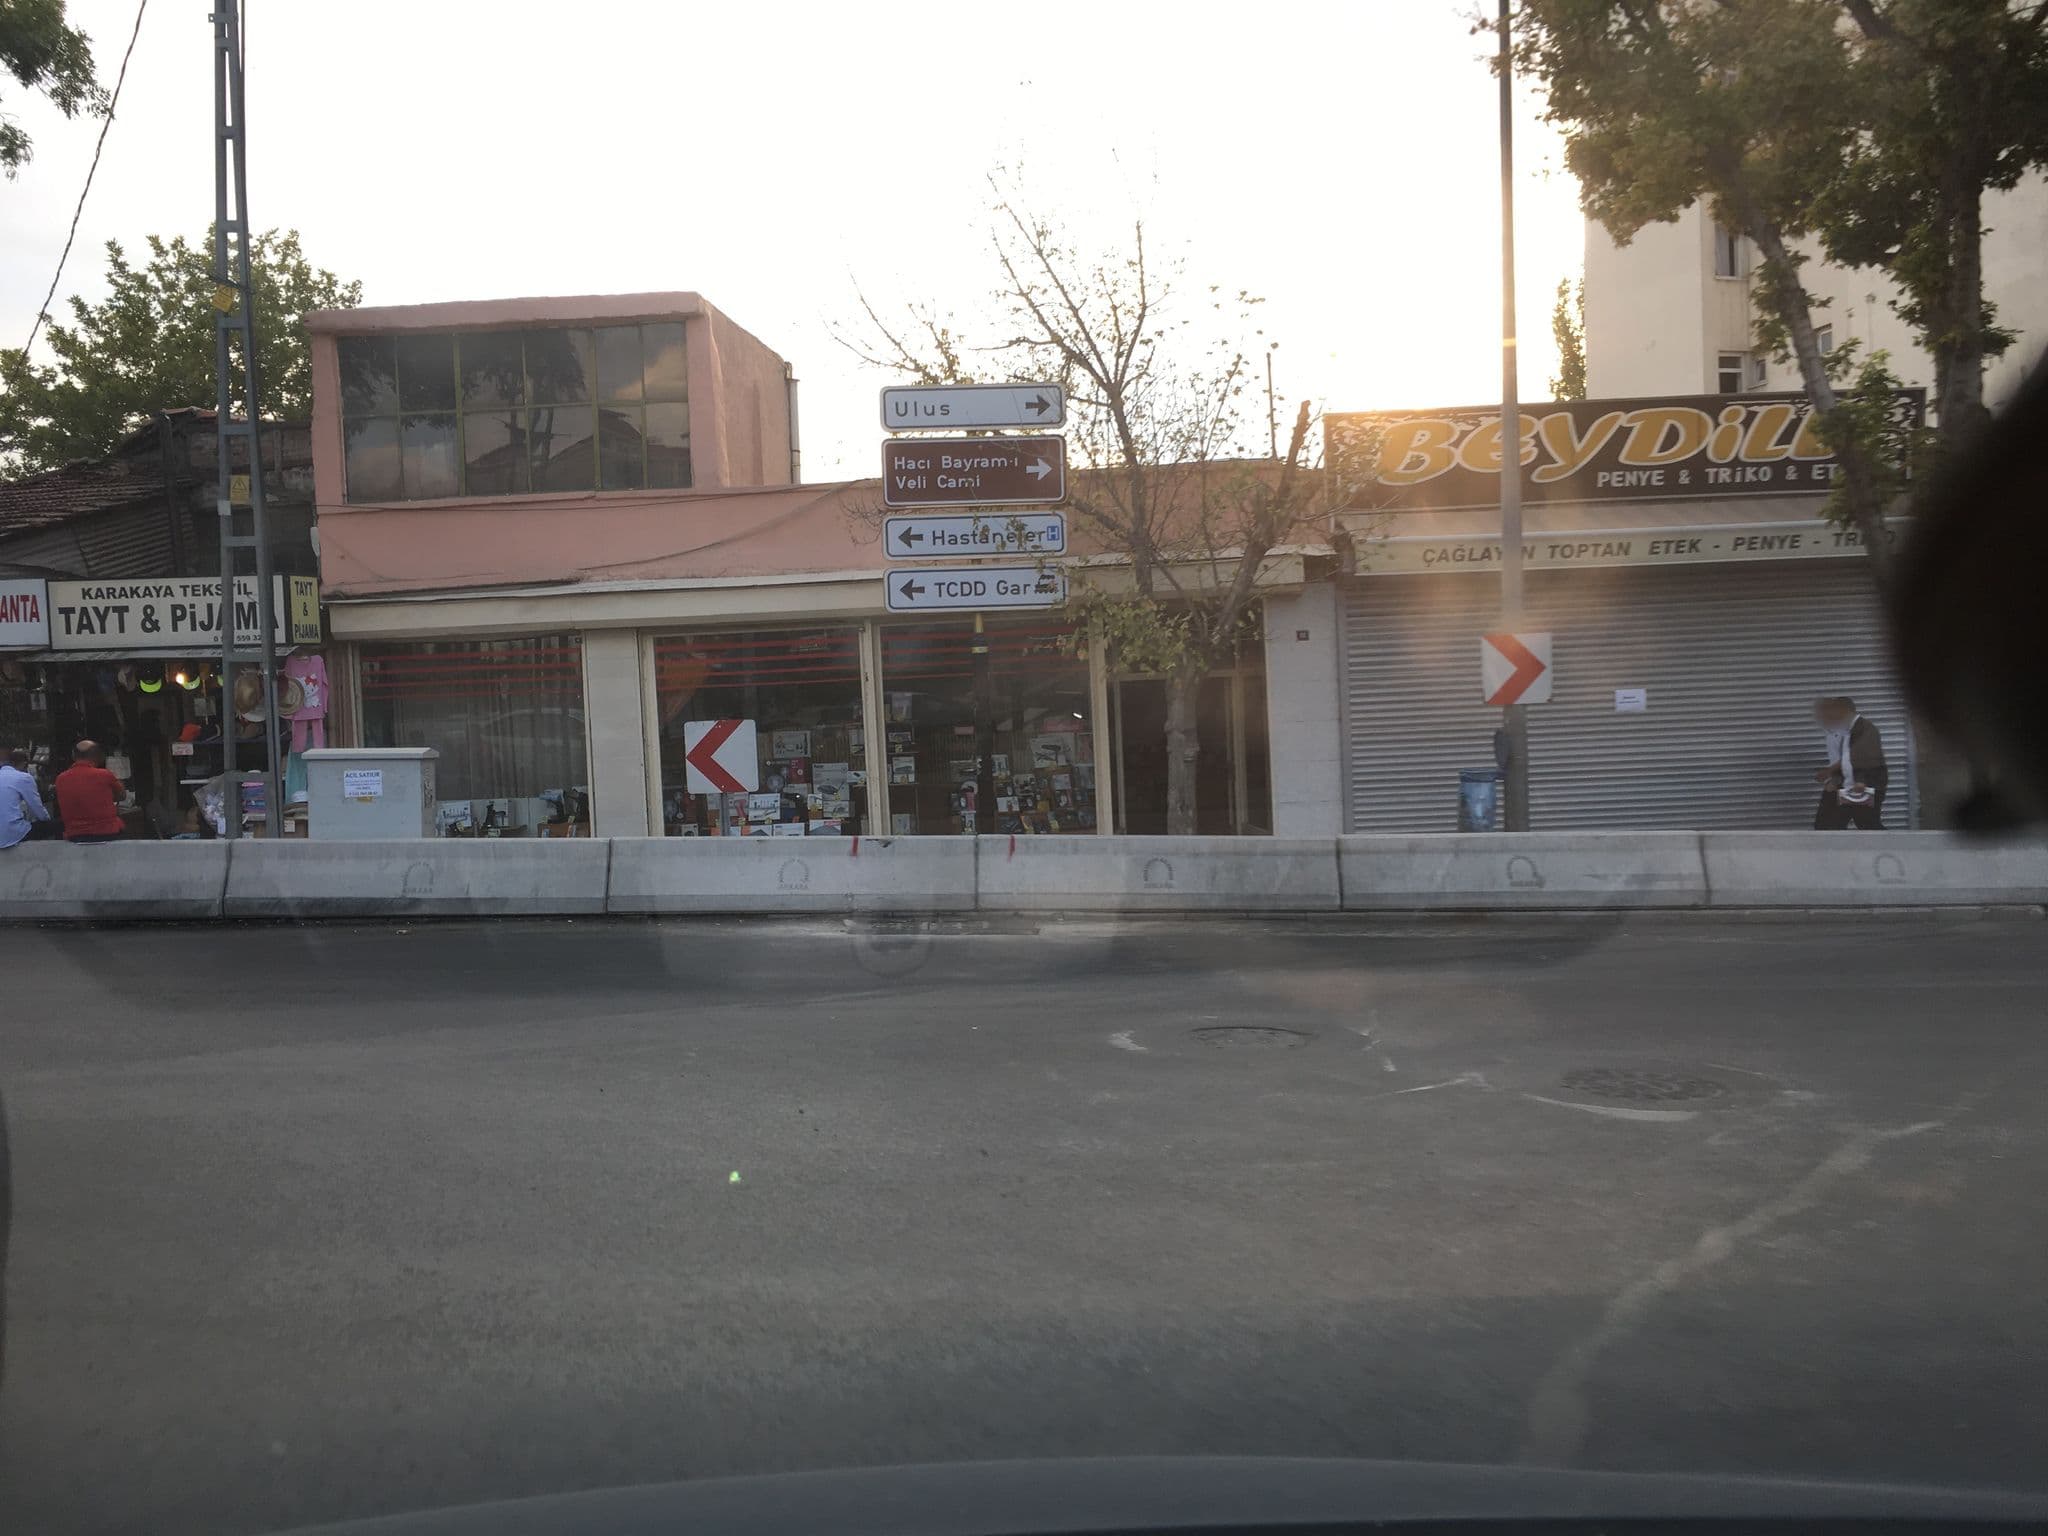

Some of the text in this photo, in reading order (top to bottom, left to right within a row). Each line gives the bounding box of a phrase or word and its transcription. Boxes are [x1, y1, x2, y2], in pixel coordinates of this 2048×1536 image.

[895, 401, 950, 417] Ulus
[894, 456, 930, 470] Hacı
[896, 474, 980, 489] Veli Cami
[1597, 469, 1665, 488] PENYE
[1677, 469, 1691, 484] &
[1785, 465, 1799, 481] &
[932, 529, 1046, 546] Hastaneer
[1422, 543, 1536, 567] ÇAĞLAYN
[1546, 541, 1632, 560] TOPTAN
[1649, 538, 1702, 556] ETEK
[1732, 534, 1802, 551] PENYE
[81, 580, 253, 600] KARAKAYA TEKSİL
[294, 581, 313, 597] TAYT
[934, 579, 1031, 598] TCDD Gar
[302, 601, 309, 617] &
[58, 601, 279, 635] TAYT & PiJM
